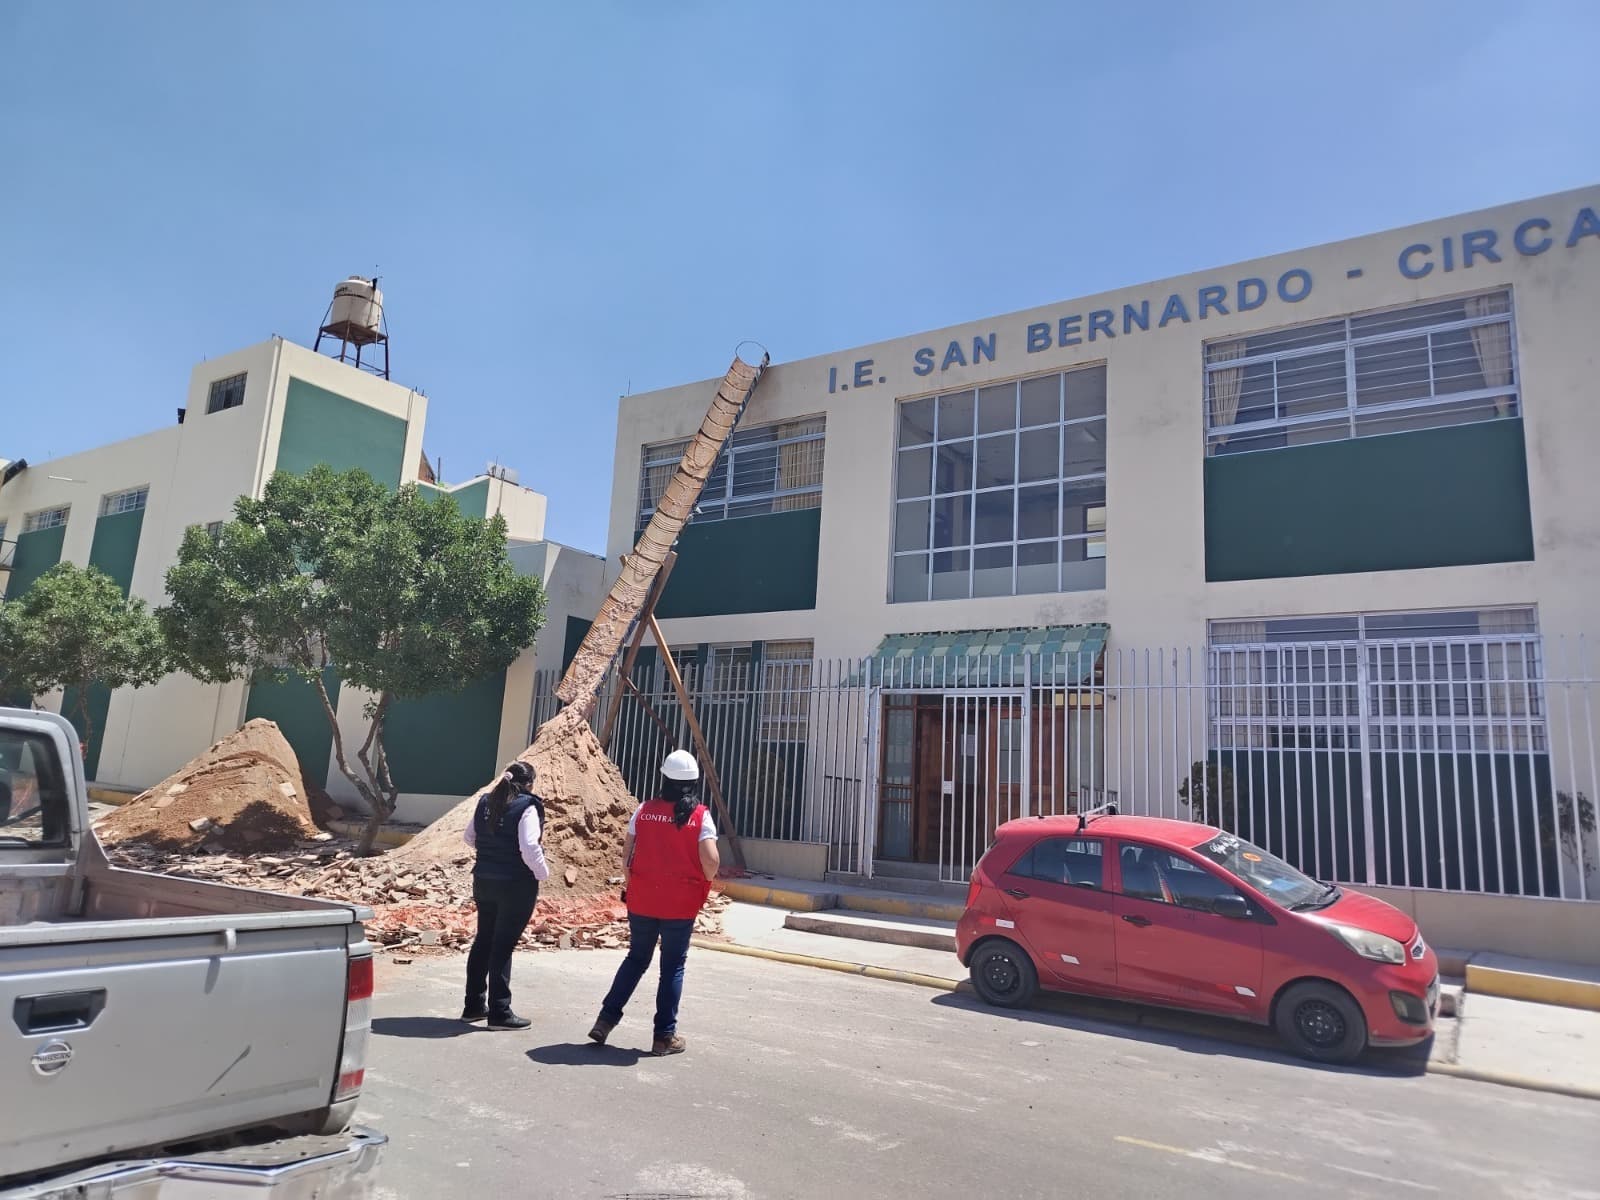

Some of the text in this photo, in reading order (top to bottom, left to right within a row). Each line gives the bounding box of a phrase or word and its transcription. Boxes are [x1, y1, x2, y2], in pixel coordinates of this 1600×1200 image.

[828, 207, 1600, 393] I.E. SAN BERNARDO - CIRCA
